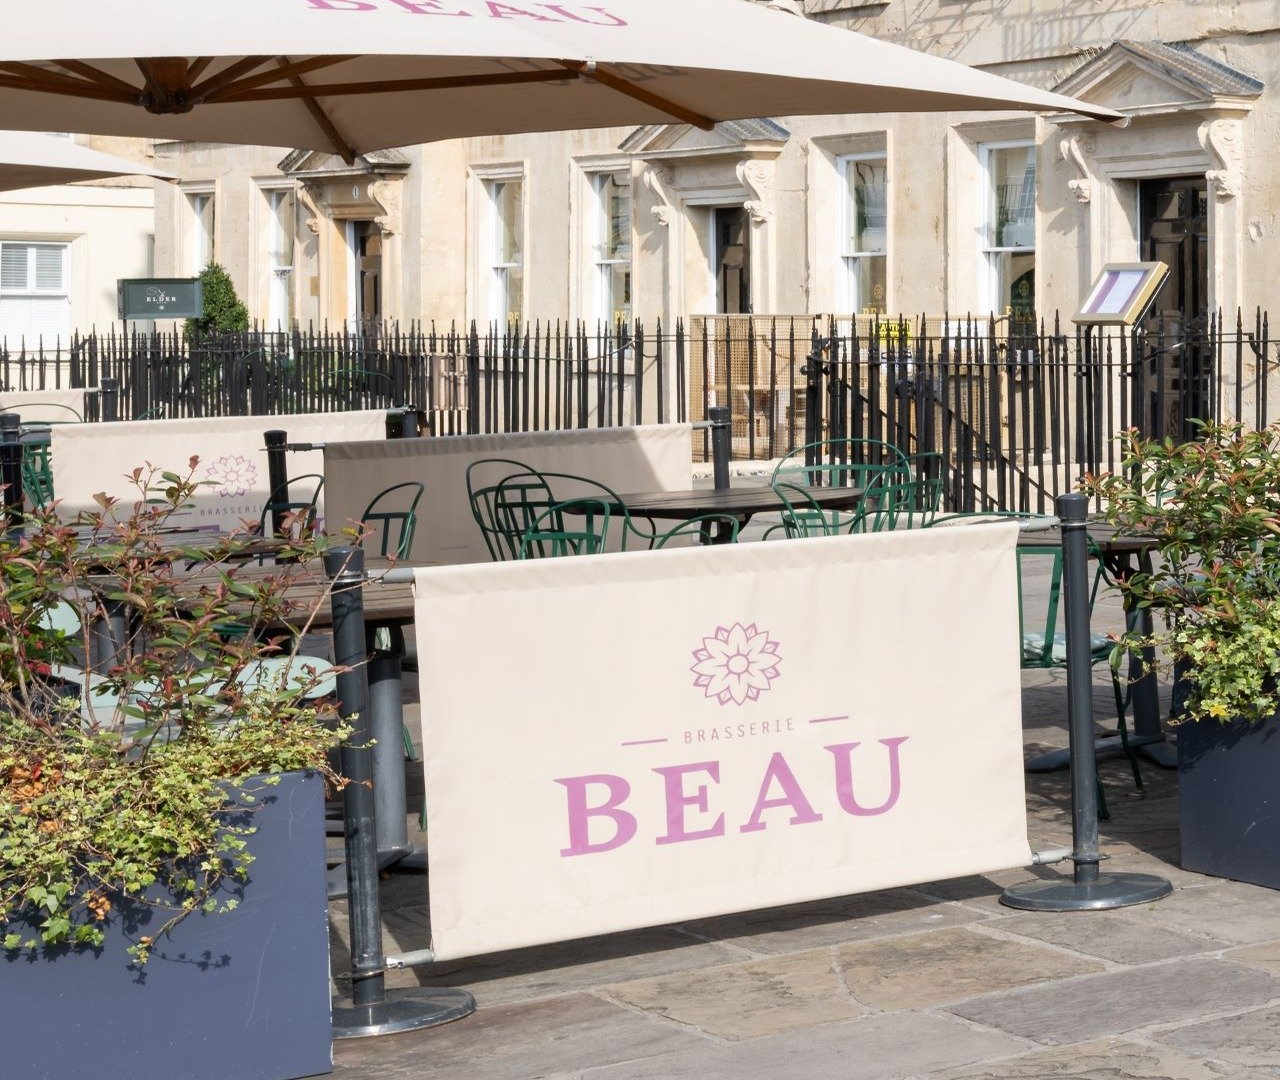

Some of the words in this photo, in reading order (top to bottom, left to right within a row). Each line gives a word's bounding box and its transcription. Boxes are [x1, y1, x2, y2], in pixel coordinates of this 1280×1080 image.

[200, 505, 264, 517] BRASSERIE
[684, 717, 796, 745] BRASSERIE
[553, 736, 910, 857] BEAU
